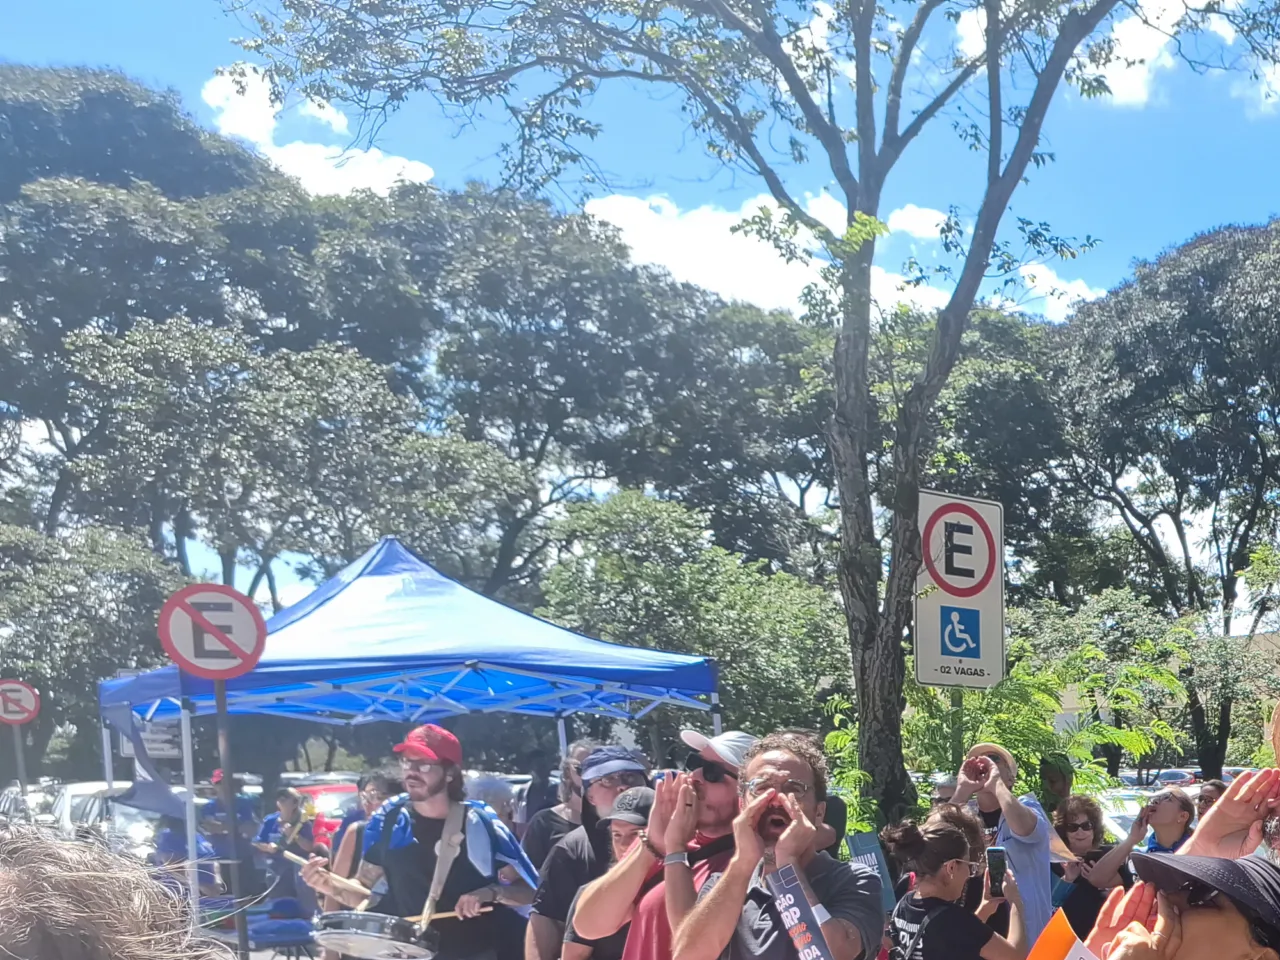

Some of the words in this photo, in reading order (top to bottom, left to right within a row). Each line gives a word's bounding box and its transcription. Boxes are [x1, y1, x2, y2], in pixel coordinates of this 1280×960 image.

[944, 521, 975, 579] E
[190, 602, 238, 659] E
[940, 665, 952, 675] 02
[954, 666, 985, 678] VAGAS
